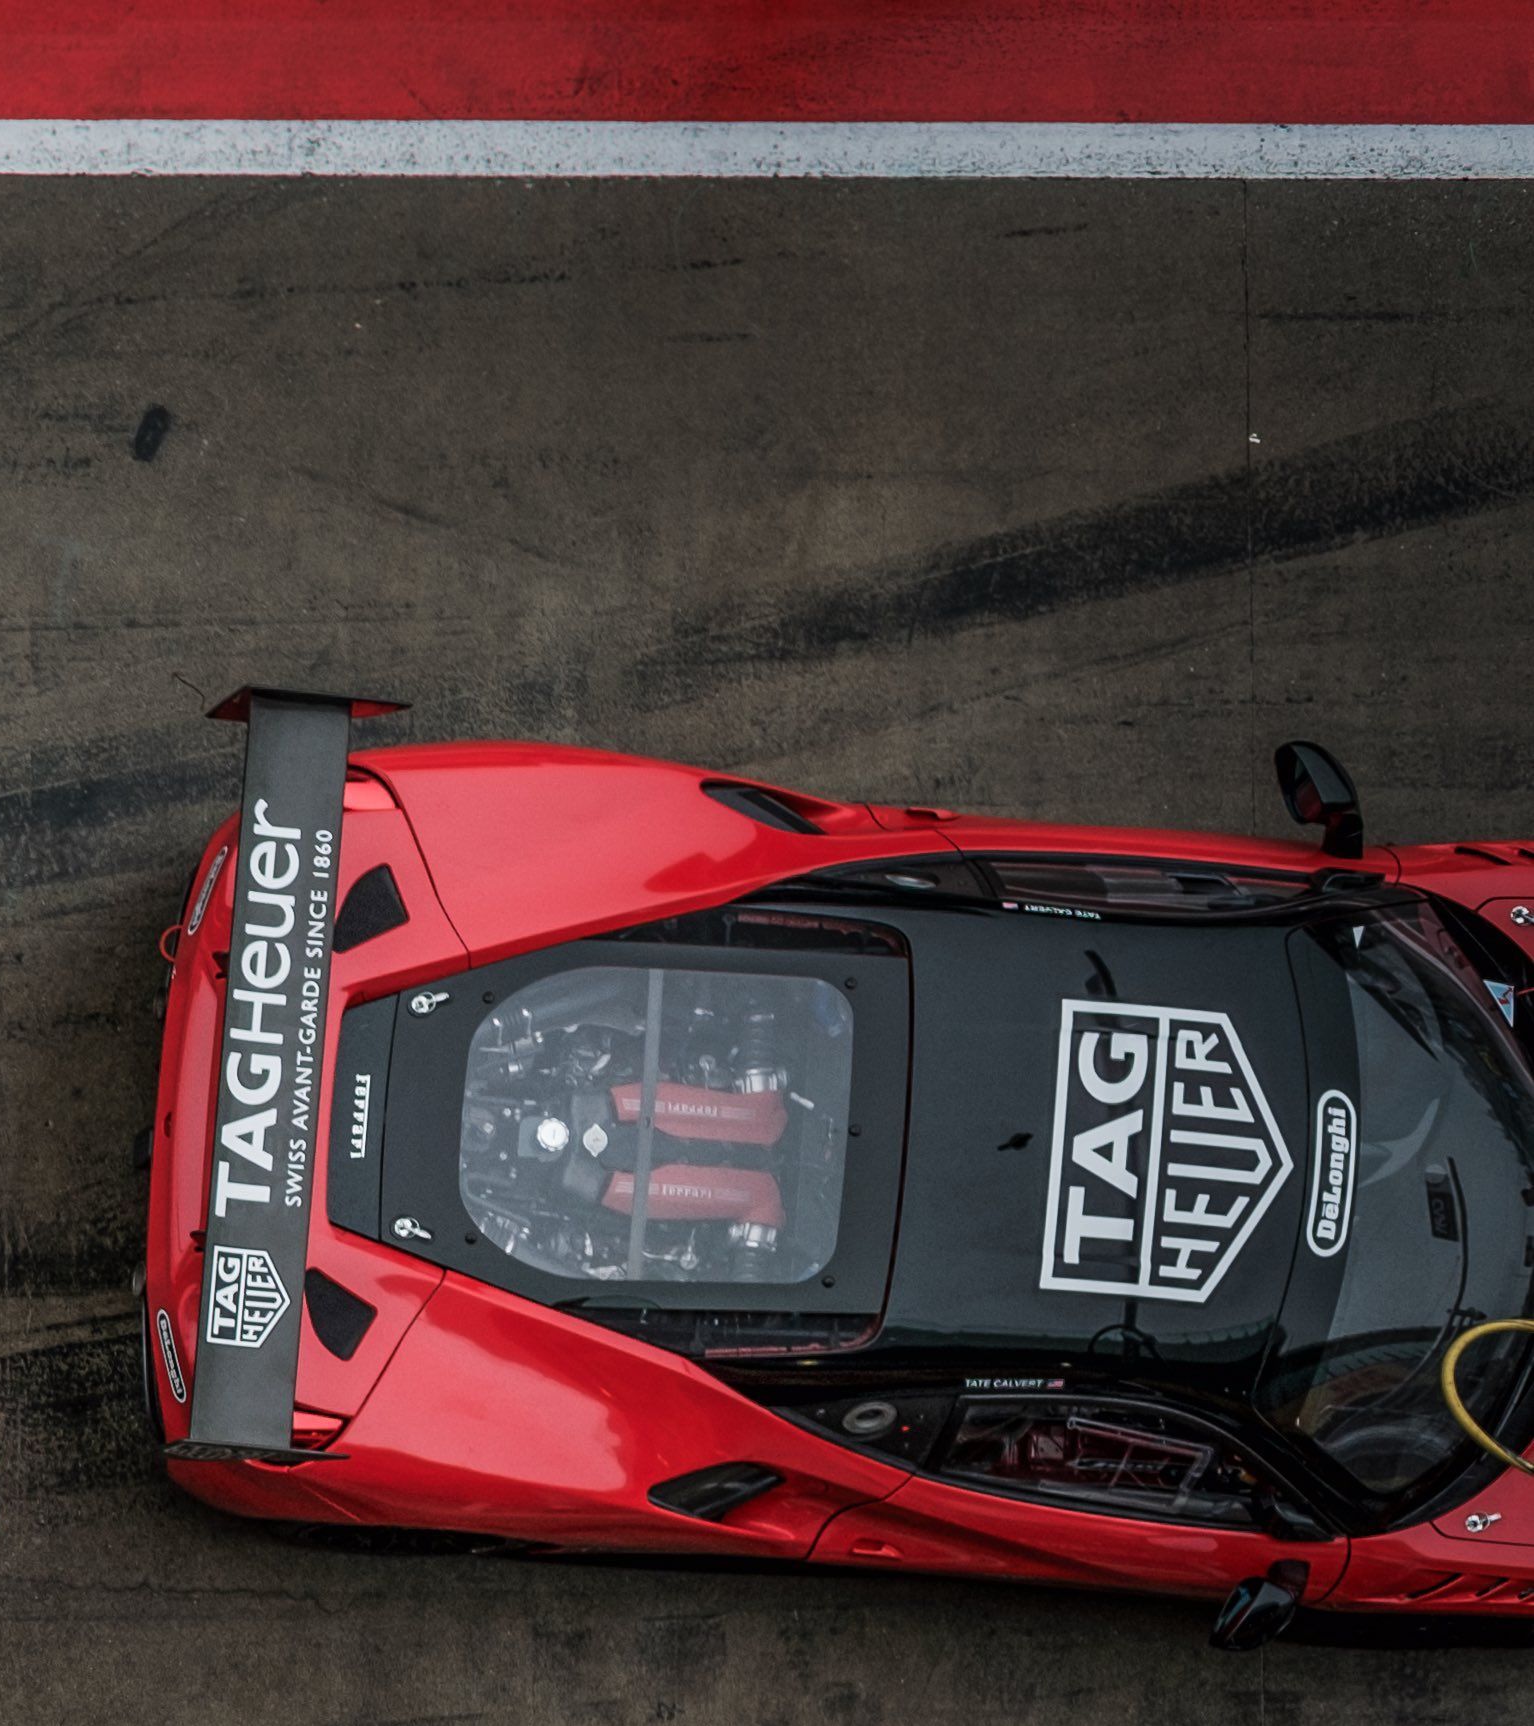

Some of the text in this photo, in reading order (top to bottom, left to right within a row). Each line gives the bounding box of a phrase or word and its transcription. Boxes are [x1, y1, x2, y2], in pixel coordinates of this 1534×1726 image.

[285, 829, 333, 1208] SWISS AVANT-GARDE SINCE 1860
[1064, 1028, 1149, 1265] TAG
[1158, 1027, 1280, 1281] HEUER
[212, 1252, 240, 1337] TAG
[241, 1257, 285, 1342] HEUER
[965, 1378, 1043, 1388] TATE CALVERT
